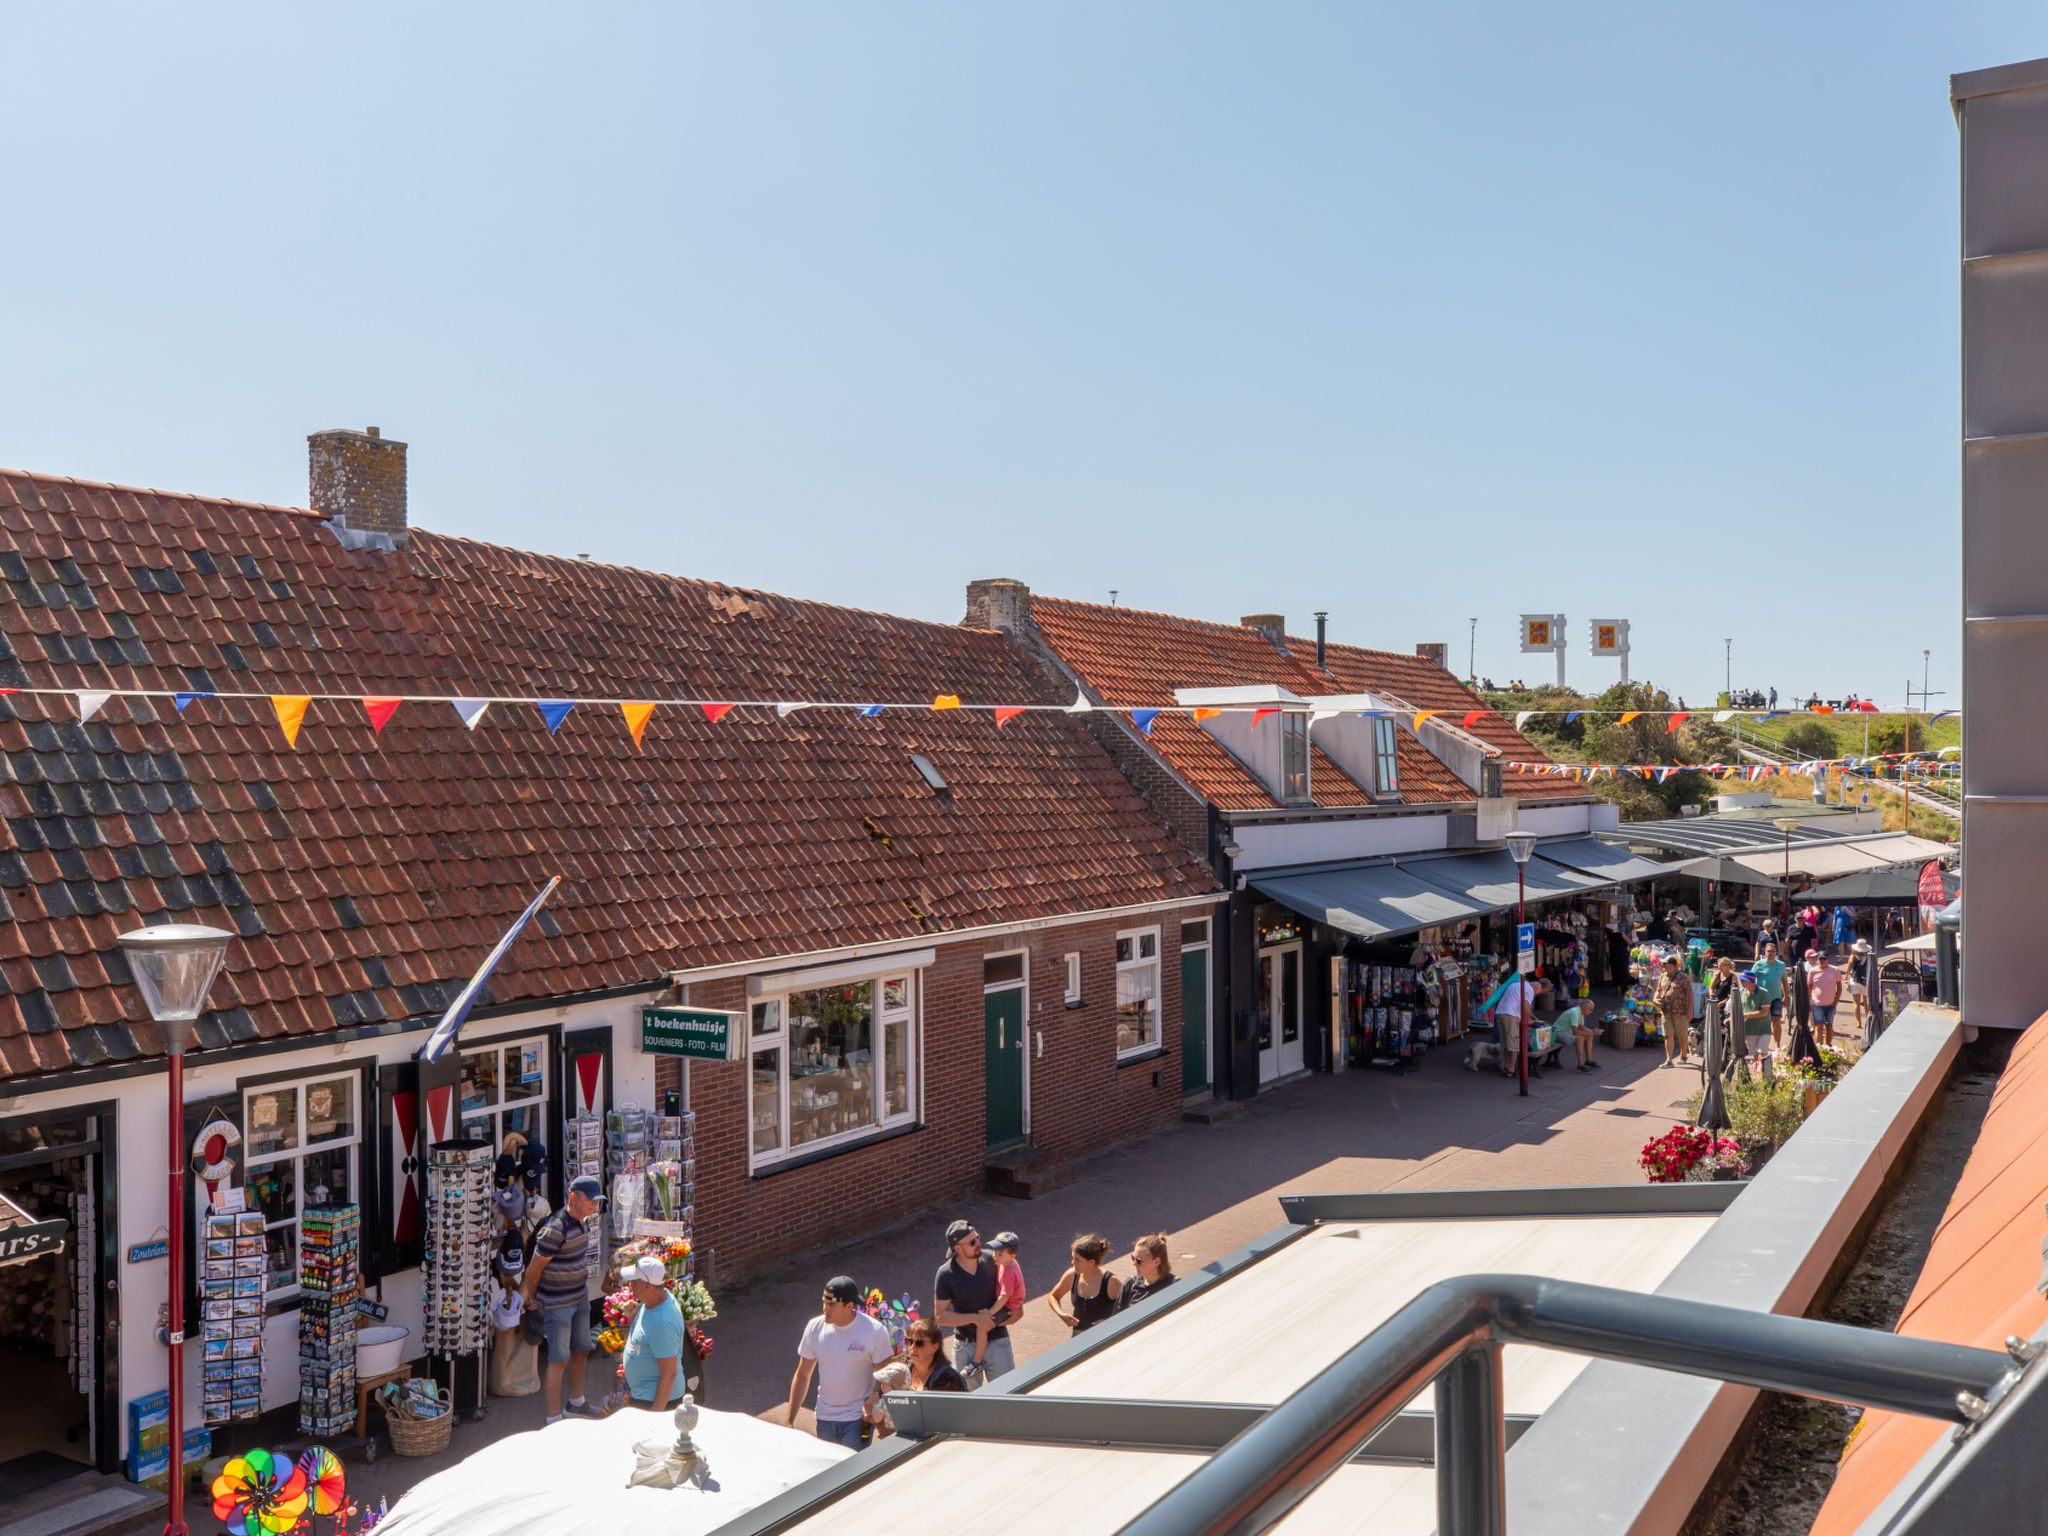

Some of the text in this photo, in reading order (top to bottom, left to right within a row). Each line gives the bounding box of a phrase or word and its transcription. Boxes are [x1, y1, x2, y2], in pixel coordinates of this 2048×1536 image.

[1919, 892, 1945, 903] Vis
[654, 1016, 726, 1036] boekenhuisje
[644, 1035, 684, 1049] SOUVENIERS
[688, 1039, 706, 1050] FOTO
[710, 1041, 726, 1052] FILM
